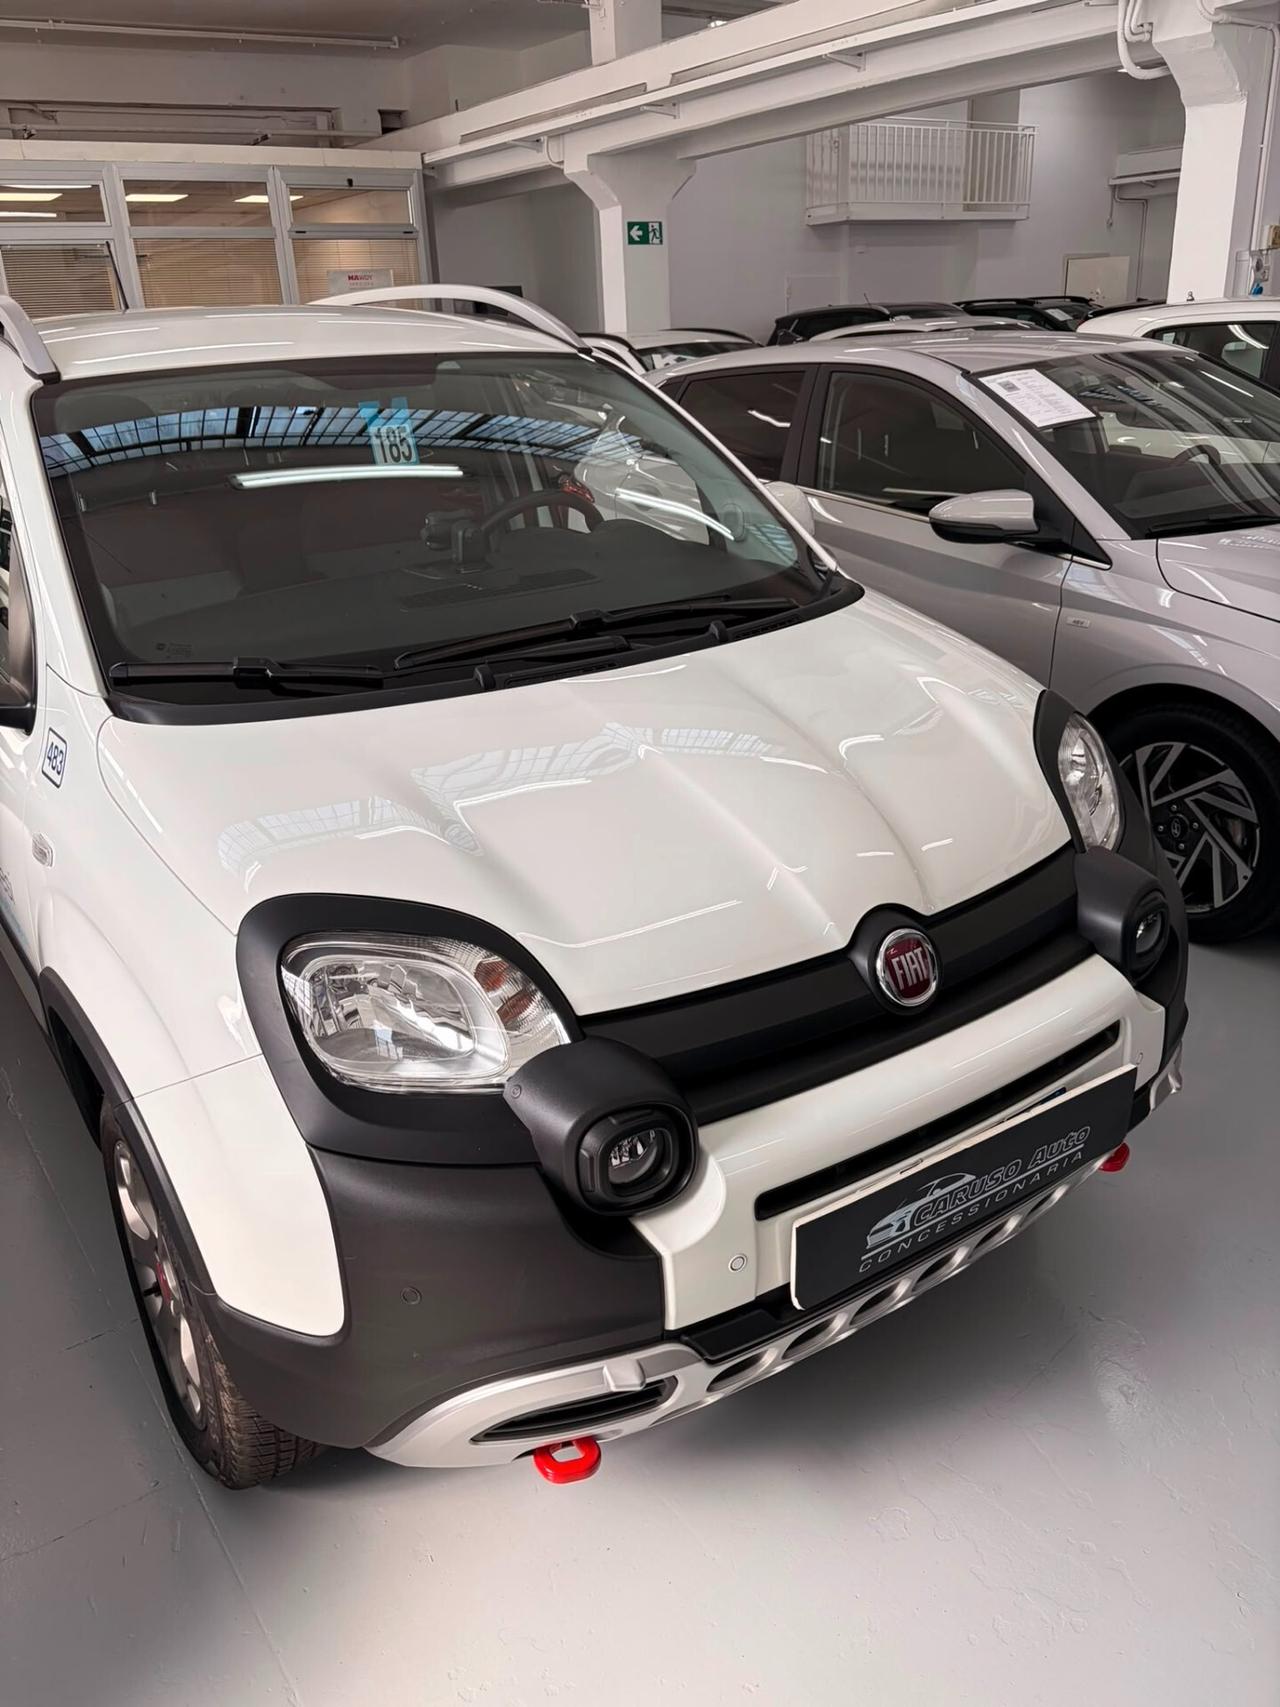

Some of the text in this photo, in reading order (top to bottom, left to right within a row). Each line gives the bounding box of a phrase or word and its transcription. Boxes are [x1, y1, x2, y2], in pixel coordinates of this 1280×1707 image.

[374, 426, 413, 463] 185
[47, 741, 64, 776] 483
[891, 946, 929, 991] FIAT
[859, 1151, 1082, 1273] CONCESSIONARIA
[914, 1159, 1022, 1227] CARUSO
